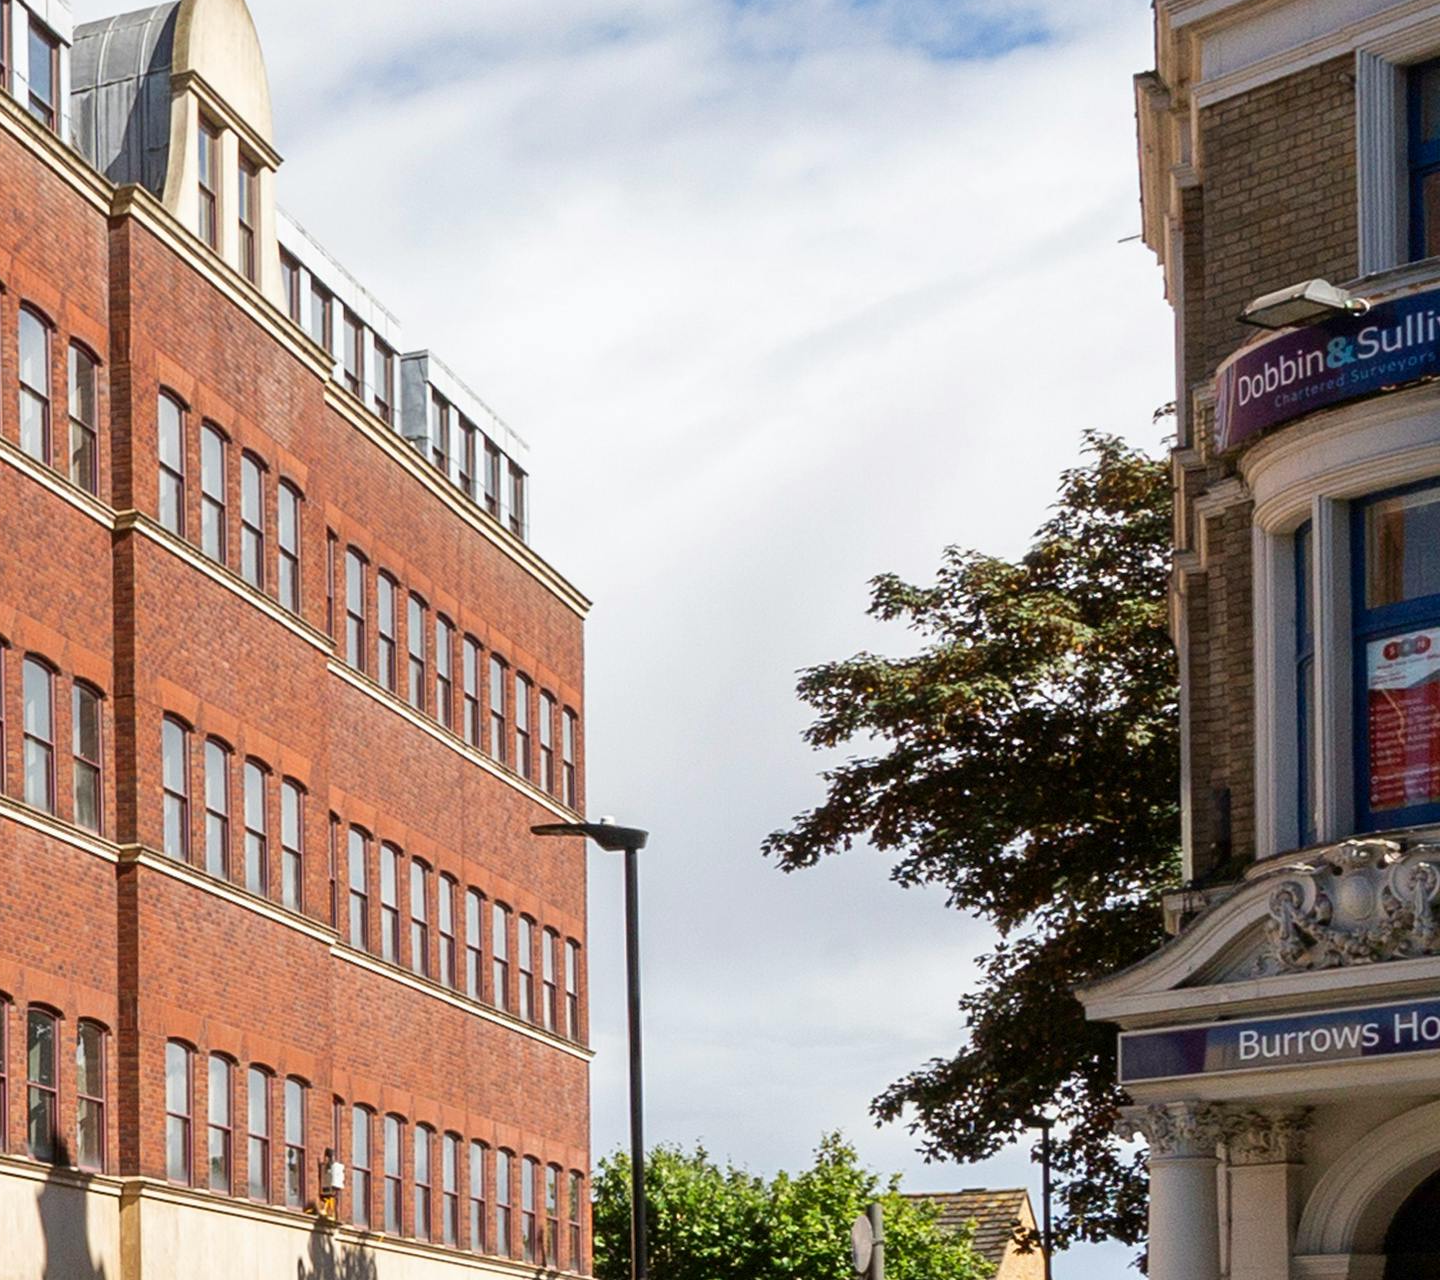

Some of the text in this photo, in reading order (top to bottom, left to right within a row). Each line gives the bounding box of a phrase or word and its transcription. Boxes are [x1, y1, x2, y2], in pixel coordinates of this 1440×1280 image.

[1275, 351, 1436, 408] Chartered Surveyors
[1239, 1023, 1380, 1060] Burrows
